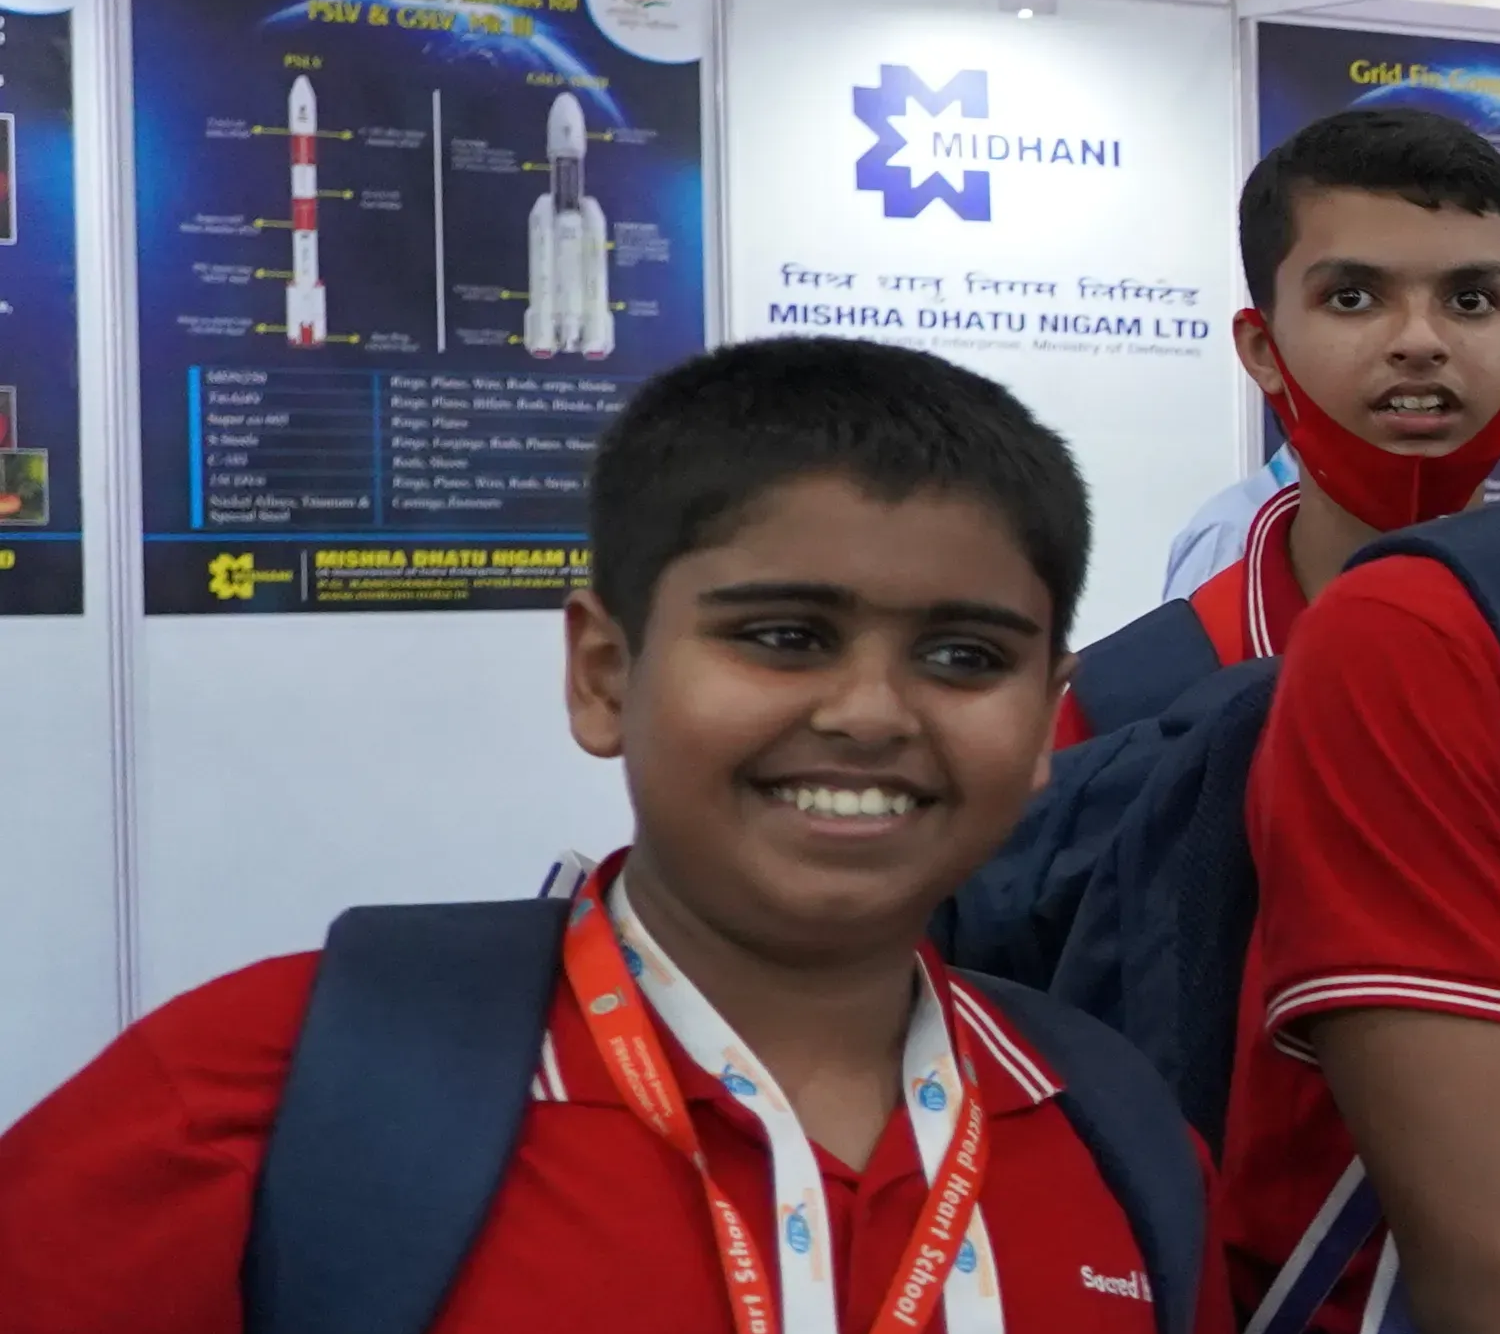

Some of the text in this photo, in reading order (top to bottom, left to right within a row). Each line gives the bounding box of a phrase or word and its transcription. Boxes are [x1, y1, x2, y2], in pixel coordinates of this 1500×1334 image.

[367, 4, 389, 27] &
[1349, 59, 1402, 85] Grid
[1408, 64, 1442, 87] Fin
[931, 131, 1123, 168] MIDHANI
[768, 301, 1210, 340] MISHRA DHATU NIGAM LTD
[315, 549, 408, 568] MISHRA
[412, 549, 488, 568] DHATU
[928, 1172, 974, 1243] Heart
[715, 1199, 758, 1283] School
[892, 1243, 948, 1329] School
